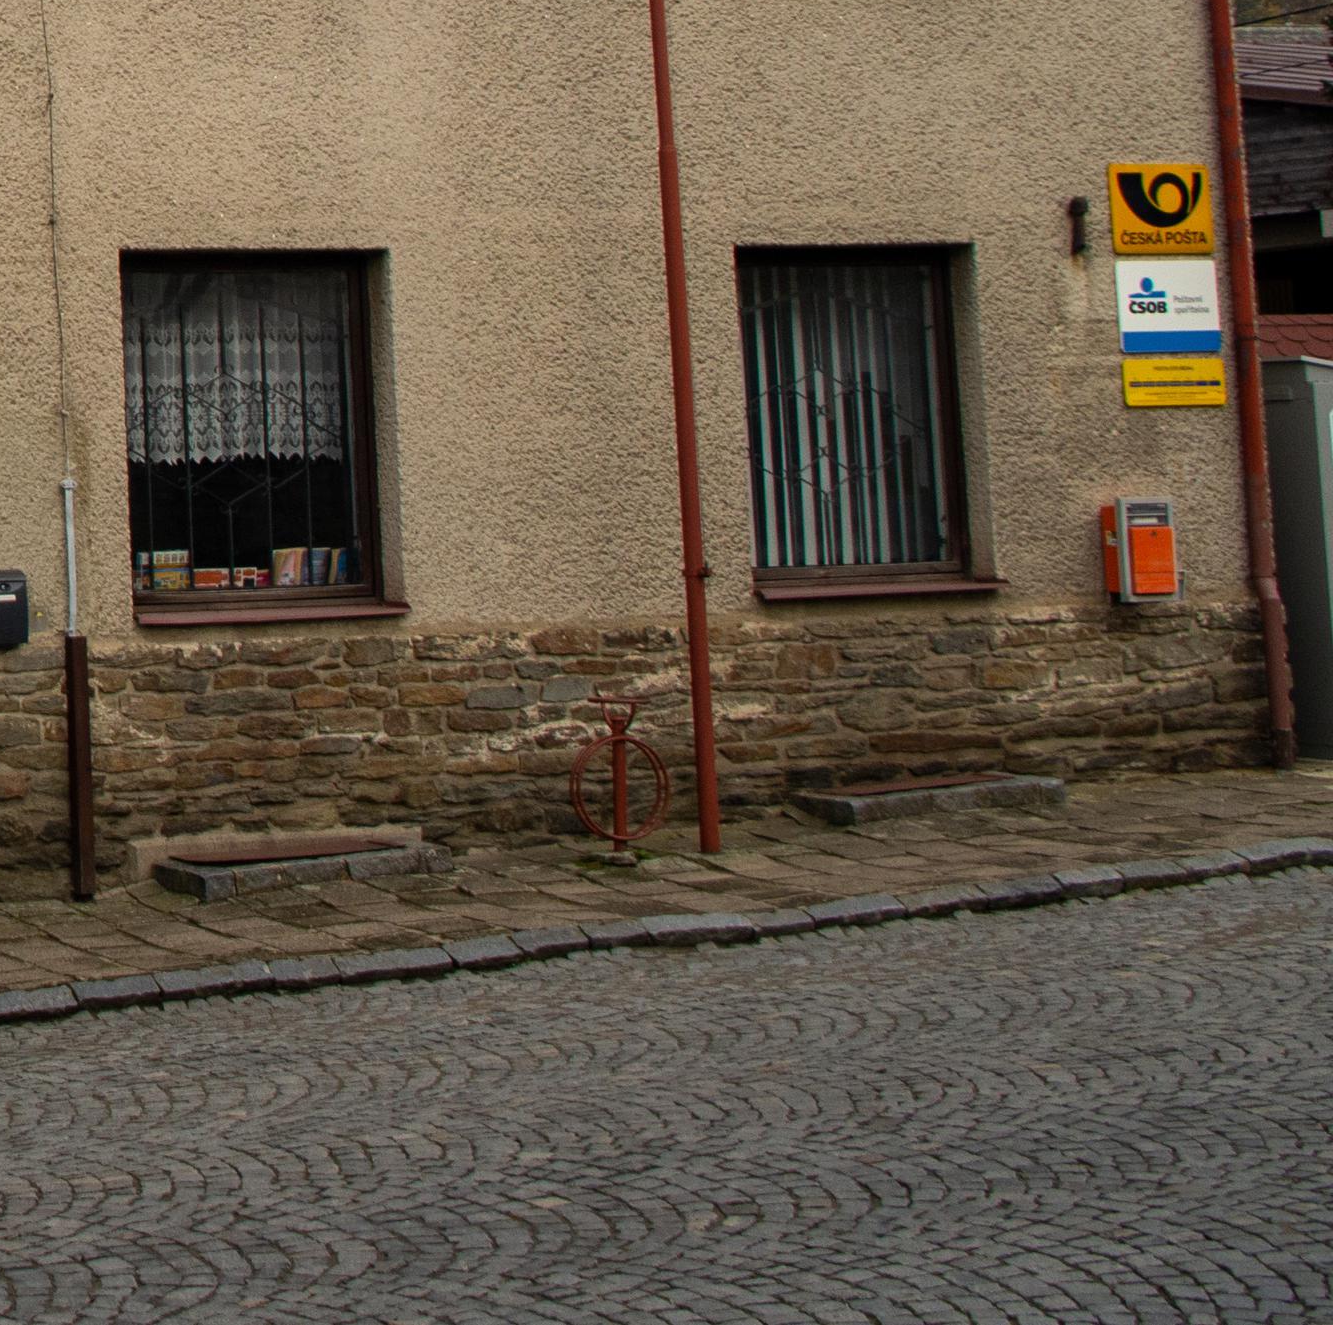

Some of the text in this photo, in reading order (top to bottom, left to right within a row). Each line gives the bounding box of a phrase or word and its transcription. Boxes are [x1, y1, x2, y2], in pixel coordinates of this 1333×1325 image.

[1121, 229, 1207, 246] ČESKÁ POŠTA
[1129, 300, 1167, 314] ČSOB
